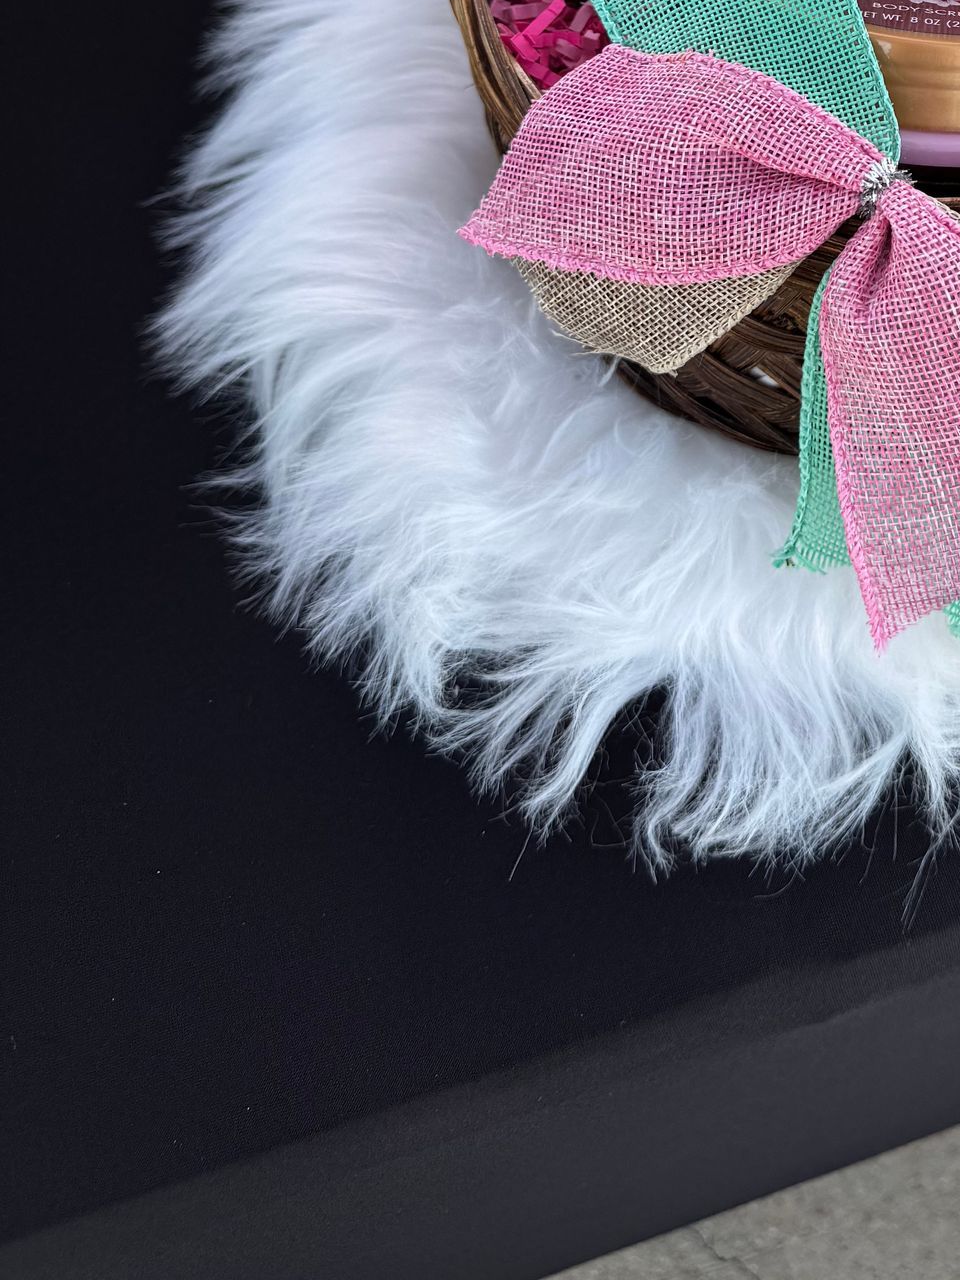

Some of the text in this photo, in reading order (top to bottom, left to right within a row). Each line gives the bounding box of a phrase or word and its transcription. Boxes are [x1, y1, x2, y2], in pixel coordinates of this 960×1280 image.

[872, 2, 920, 13] BODY
[882, 12, 904, 22] WT.
[910, 16, 919, 24] 8
[924, 17, 941, 26] OZ
